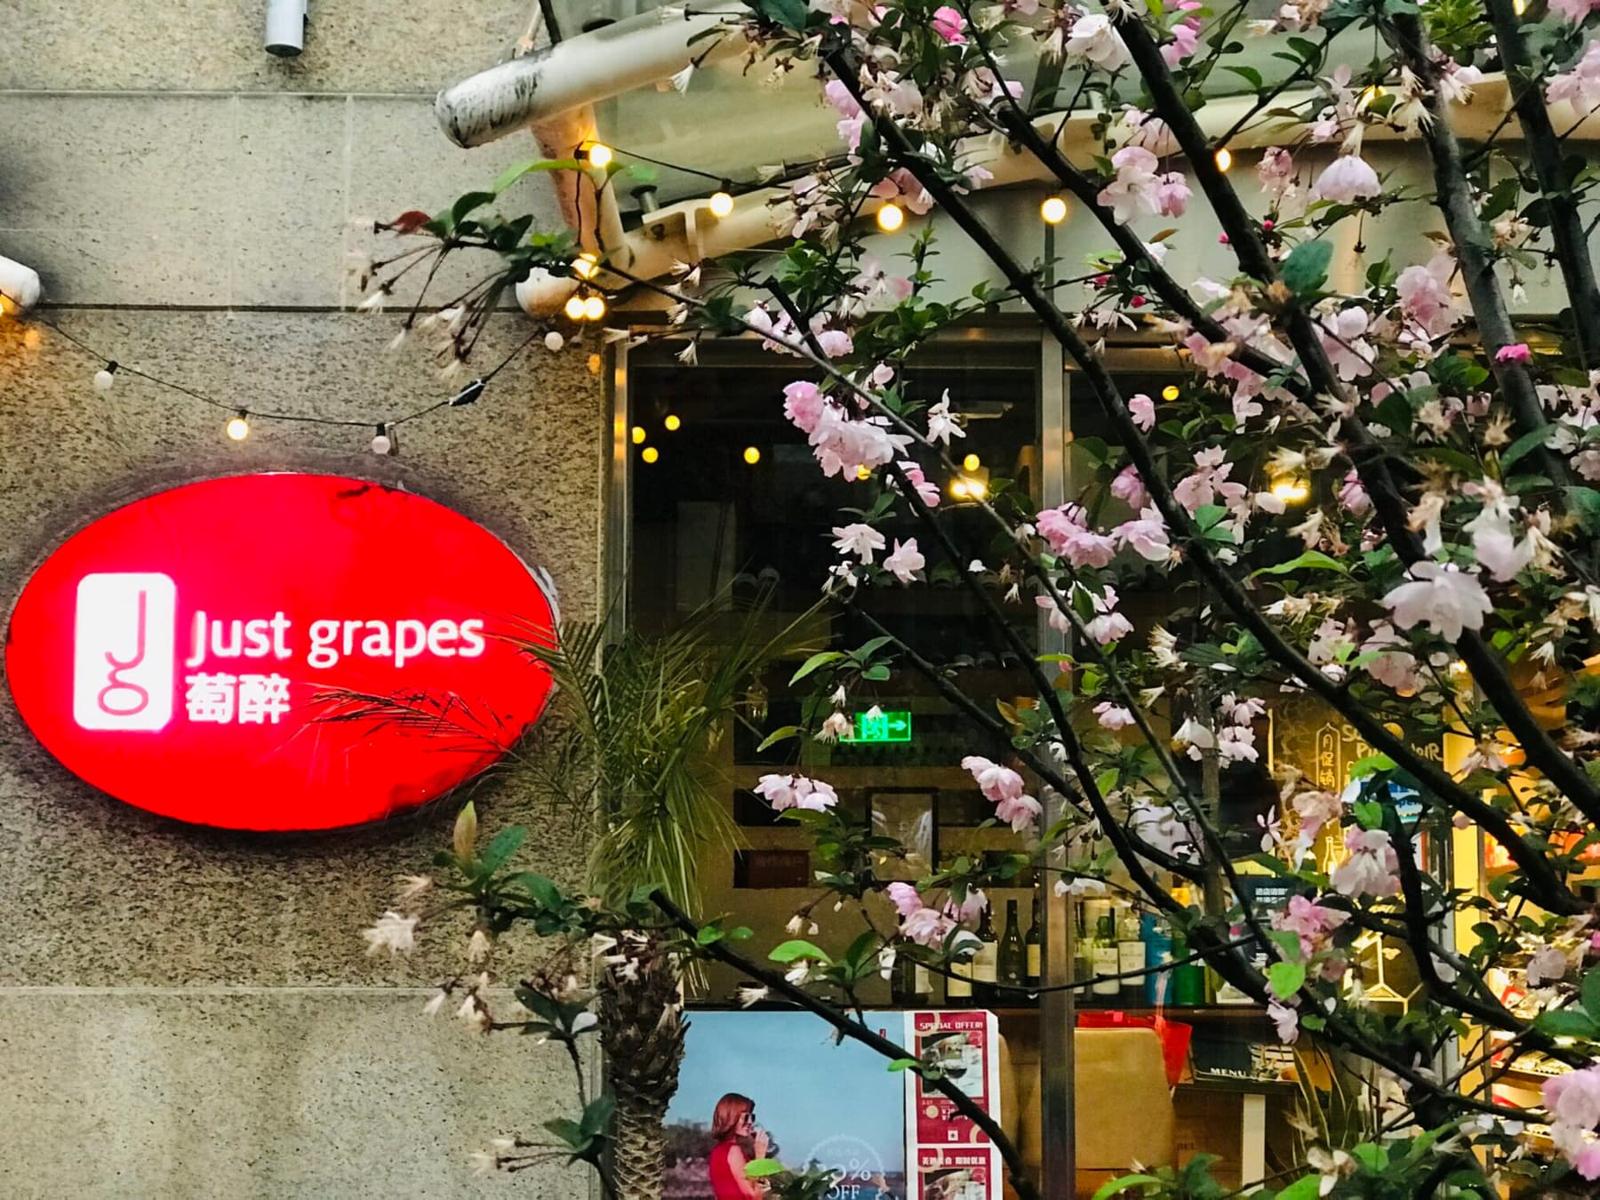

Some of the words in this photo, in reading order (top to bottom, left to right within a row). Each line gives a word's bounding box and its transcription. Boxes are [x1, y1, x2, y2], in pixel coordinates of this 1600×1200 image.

[185, 610, 293, 668] Just
[307, 619, 485, 668] grapes
[185, 672, 291, 724] 萄醉
[1210, 1067, 1246, 1077] MENU
